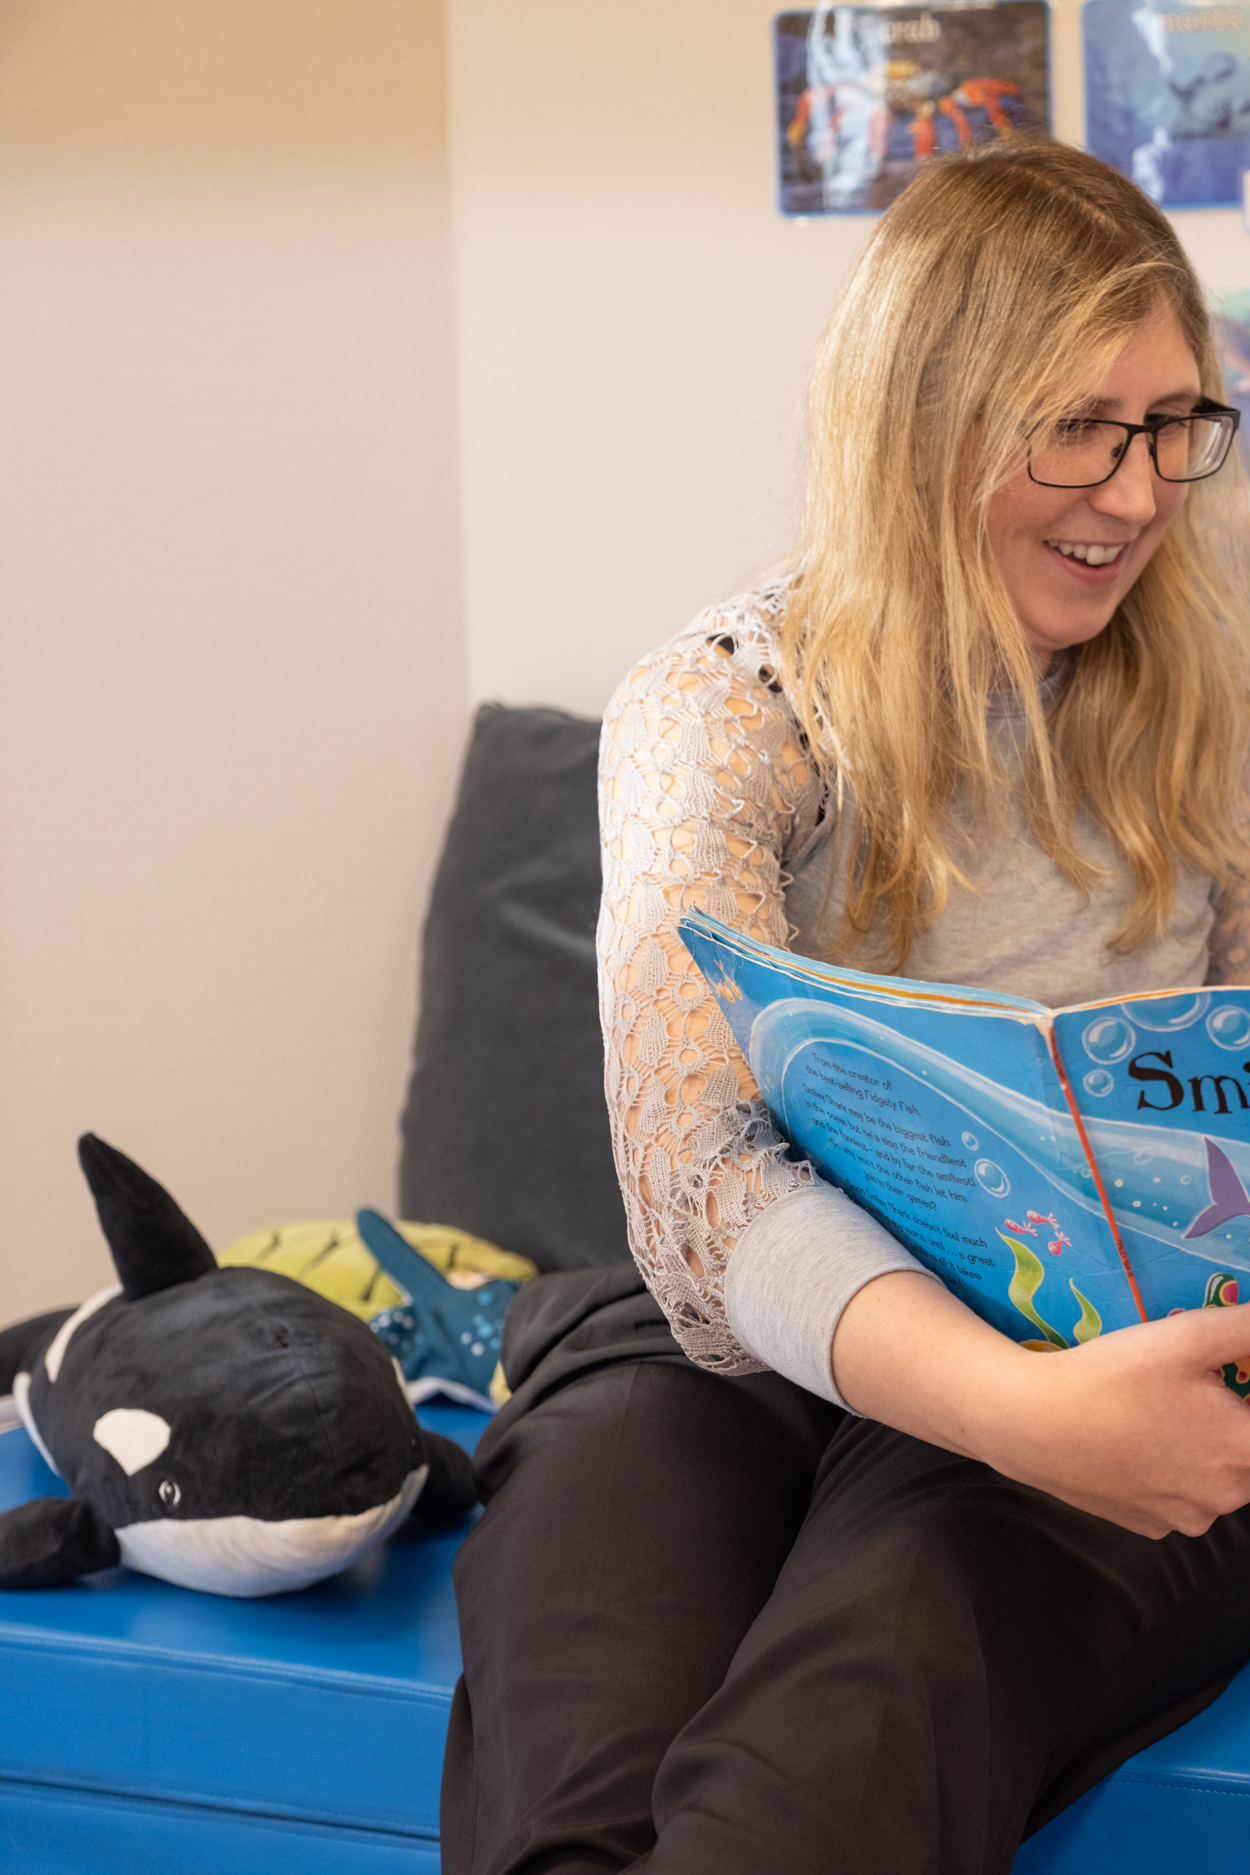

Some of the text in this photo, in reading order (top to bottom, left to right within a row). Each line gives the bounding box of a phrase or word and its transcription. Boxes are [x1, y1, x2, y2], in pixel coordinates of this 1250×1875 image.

[805, 1064, 819, 1077] the
[864, 1089, 896, 1111] Fidgety
[899, 1100, 921, 1116] Fish.
[812, 1052, 892, 1091] From the creator of
[802, 1083, 951, 1147] Smiley Shark may be the biggest fish
[812, 1102, 826, 1115] the
[826, 1111, 848, 1127] ocean
[847, 1119, 862, 1134] but
[861, 1126, 880, 1142] he's
[881, 1135, 899, 1150] also
[900, 1142, 916, 1156] the
[917, 1147, 967, 1168] friendliest
[812, 1118, 826, 1129] and
[826, 1122, 839, 1136] the
[839, 1129, 869, 1152] funniest
[875, 1151, 890, 1162] and
[890, 1153, 901, 1168] by
[902, 1158, 916, 1171] far
[918, 1165, 934, 1178] the
[936, 1172, 976, 1187] smiliest!
[829, 1138, 967, 1203] So why won't the other fish let him
[877, 1178, 886, 1188] in
[885, 1182, 904, 1196] their
[907, 1193, 937, 1211] games?
[888, 1202, 911, 1221] Shark
[912, 1214, 943, 1235] doesn't
[942, 1226, 960, 1243] feel
[961, 1236, 988, 1249] much
[927, 1235, 945, 1252] Until
[967, 1254, 996, 1267] great
[956, 1264, 982, 1280] takes
